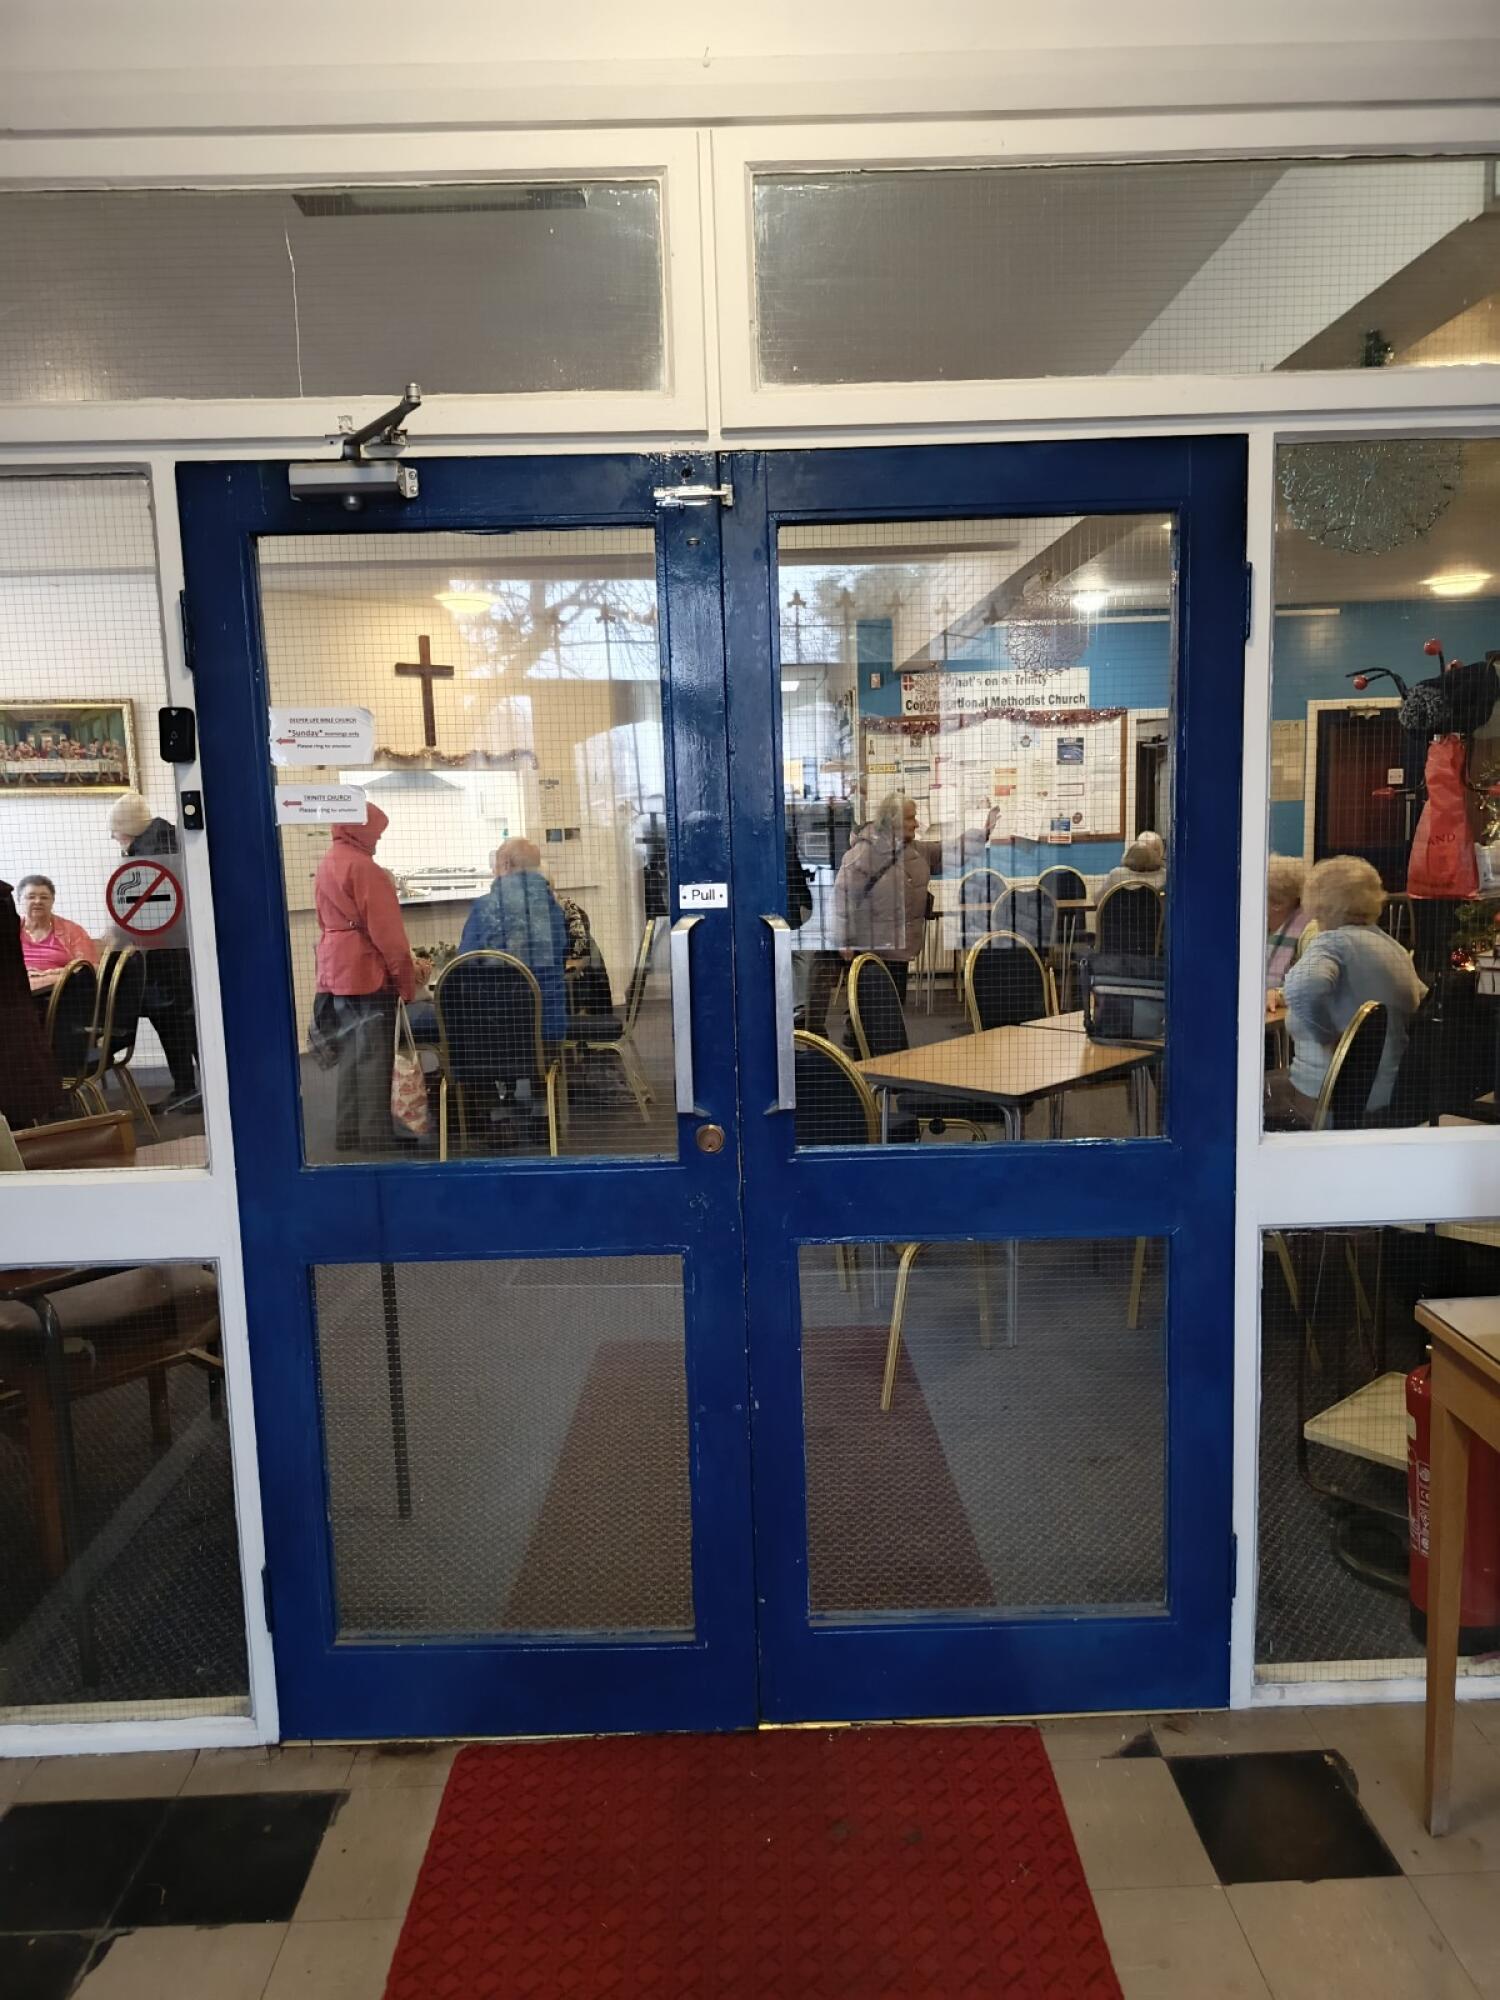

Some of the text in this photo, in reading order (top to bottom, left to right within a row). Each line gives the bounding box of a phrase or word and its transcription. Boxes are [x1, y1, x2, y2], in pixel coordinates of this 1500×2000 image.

[984, 677, 999, 686] on
[1015, 673, 1047, 686] Trinity
[905, 693, 1086, 712] Congrgational Methodist Church
[691, 888, 716, 901] Pull
